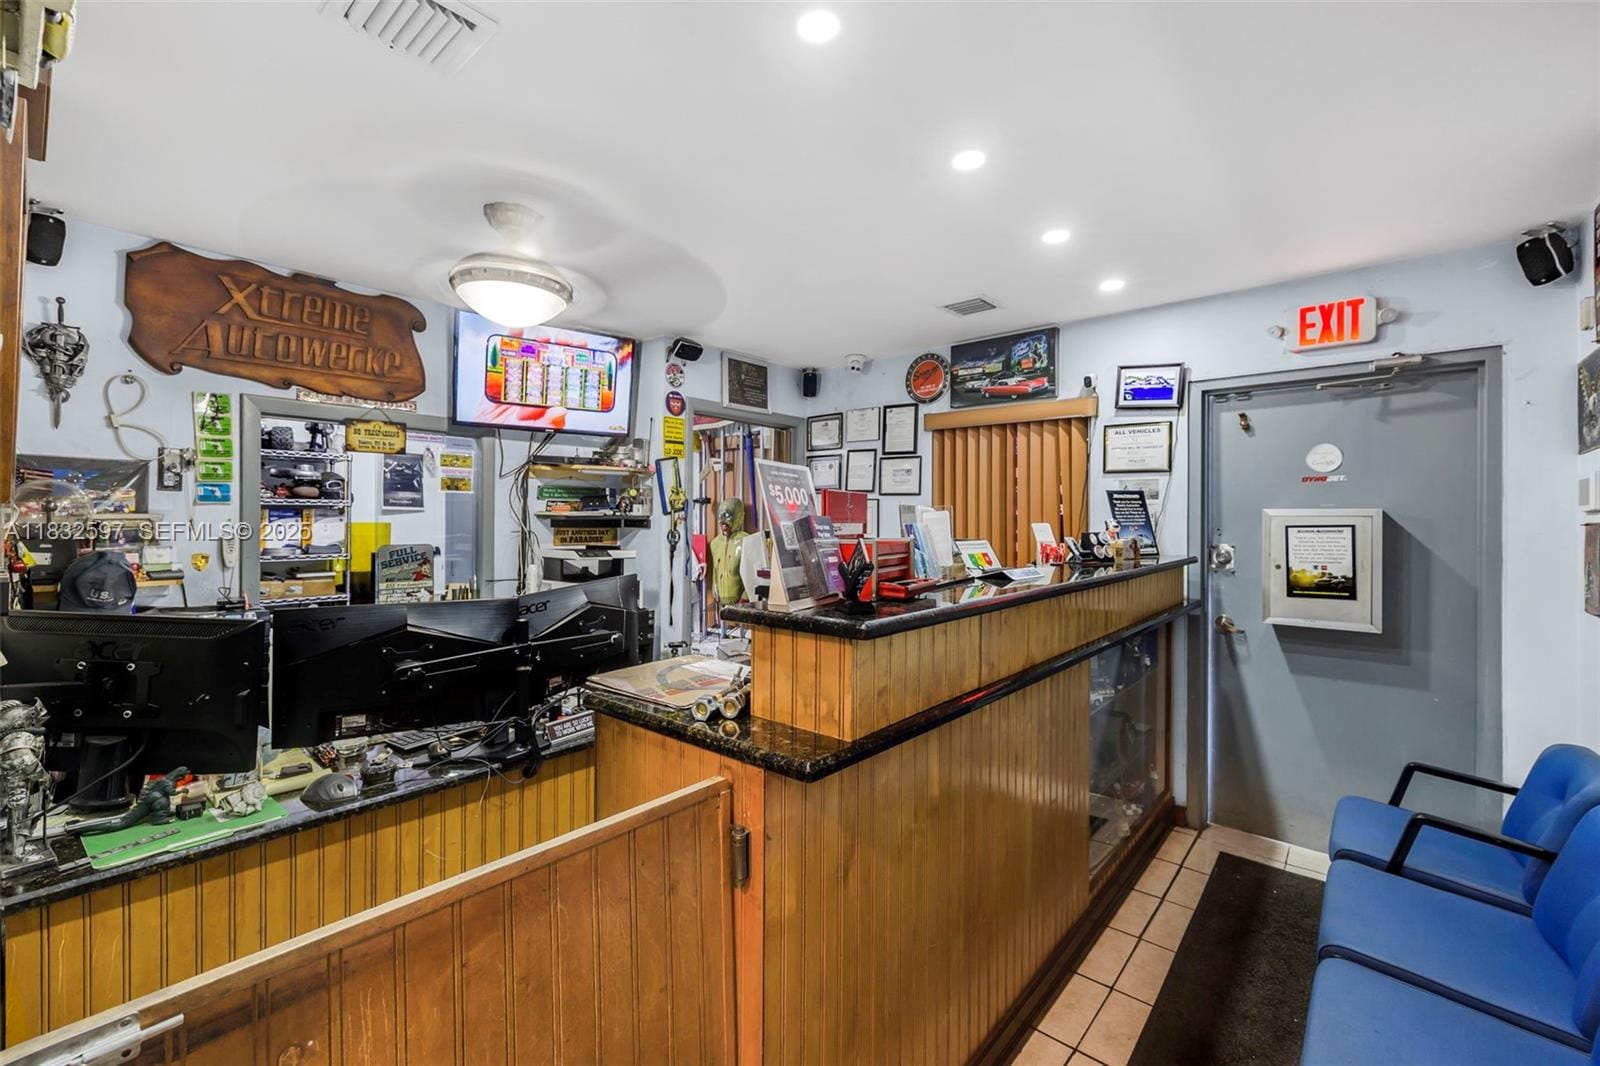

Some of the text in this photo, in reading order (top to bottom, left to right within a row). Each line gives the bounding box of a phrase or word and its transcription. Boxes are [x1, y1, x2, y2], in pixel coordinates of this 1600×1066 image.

[215, 273, 372, 335] Xtreme
[1299, 298, 1365, 347] EXIT
[569, 535, 604, 543] PARADISE
[389, 547, 417, 558] FULL
[381, 552, 428, 569] SERVICE
[518, 600, 551, 615] acer
[553, 723, 564, 731] YOU
[563, 721, 572, 729] ARE
[578, 715, 592, 724] LUCKY
[562, 726, 576, 735] WORK
